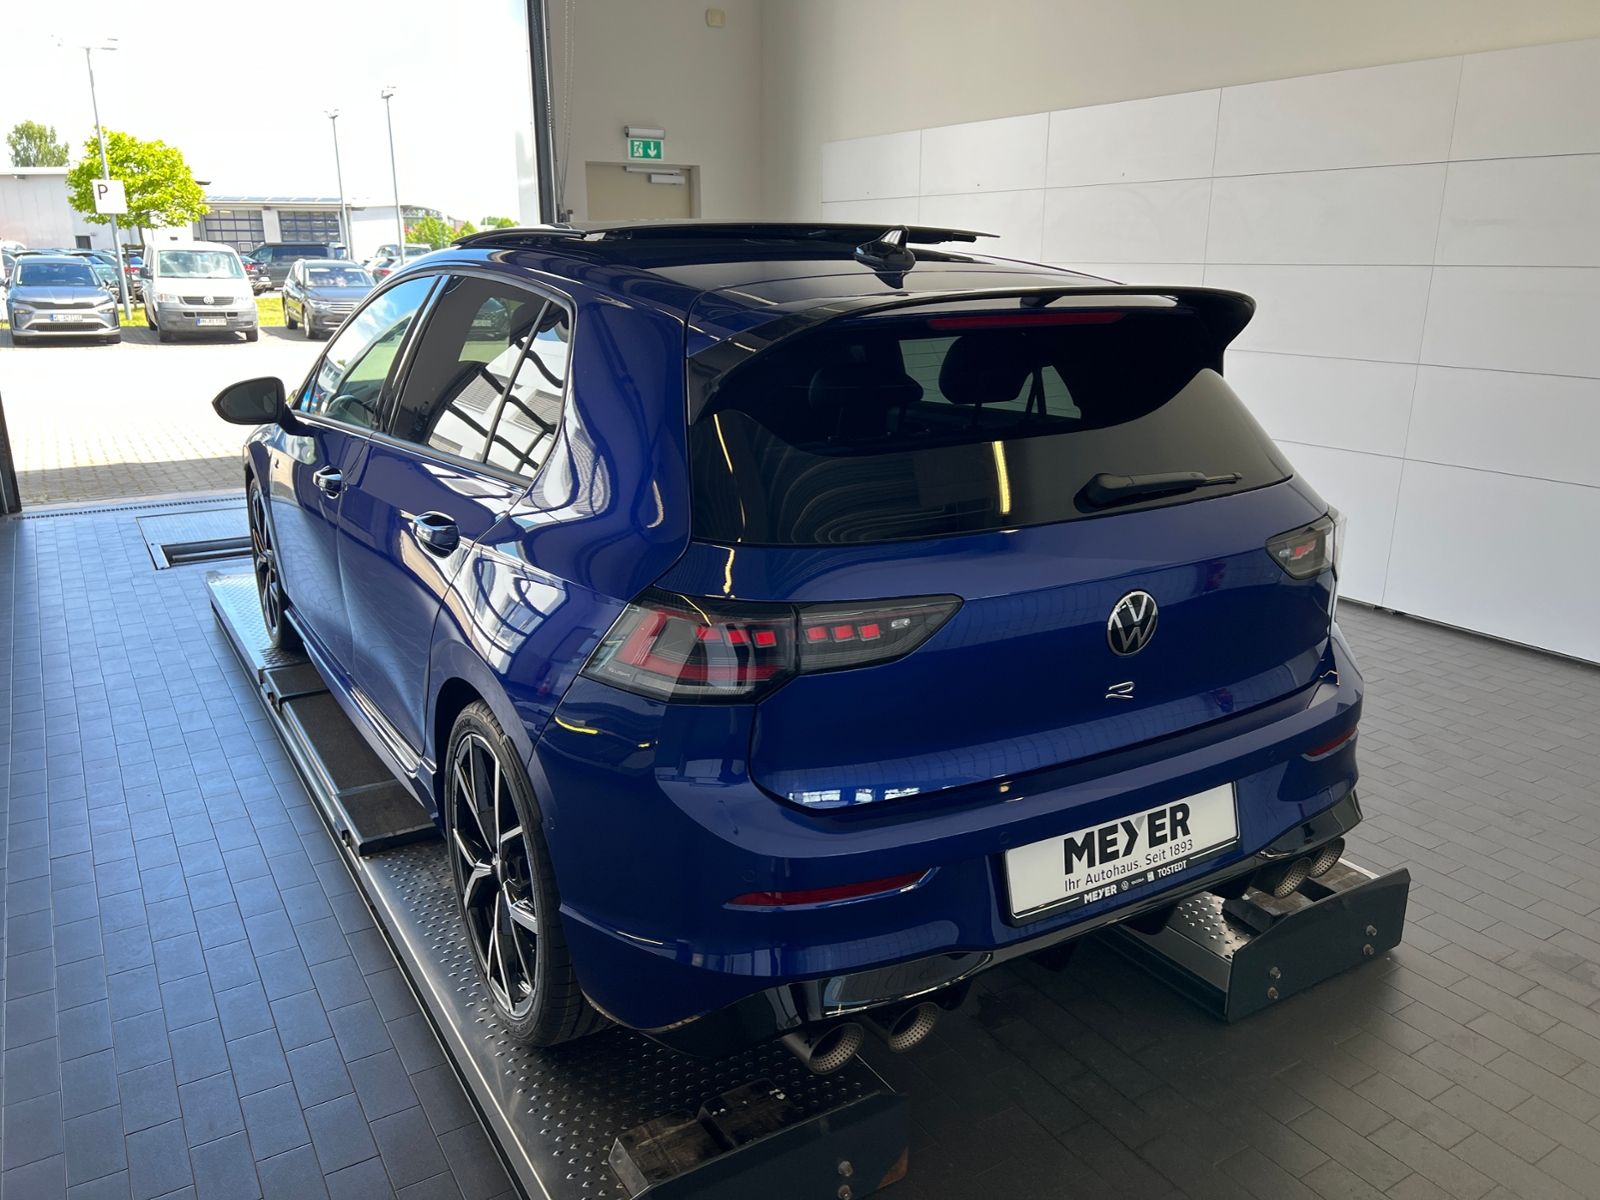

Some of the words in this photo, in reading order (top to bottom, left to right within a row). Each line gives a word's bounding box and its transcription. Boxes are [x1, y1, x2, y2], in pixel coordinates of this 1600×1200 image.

[97, 184, 108, 200] P
[1063, 802, 1191, 875] MEYER
[1064, 878, 1081, 892] Ihr
[1085, 860, 1142, 886] Autohaus.
[1145, 849, 1166, 866] Seit
[1169, 839, 1193, 857] 1893
[1083, 884, 1118, 904] MEYER
[1157, 860, 1188, 878] TOSTEDT
